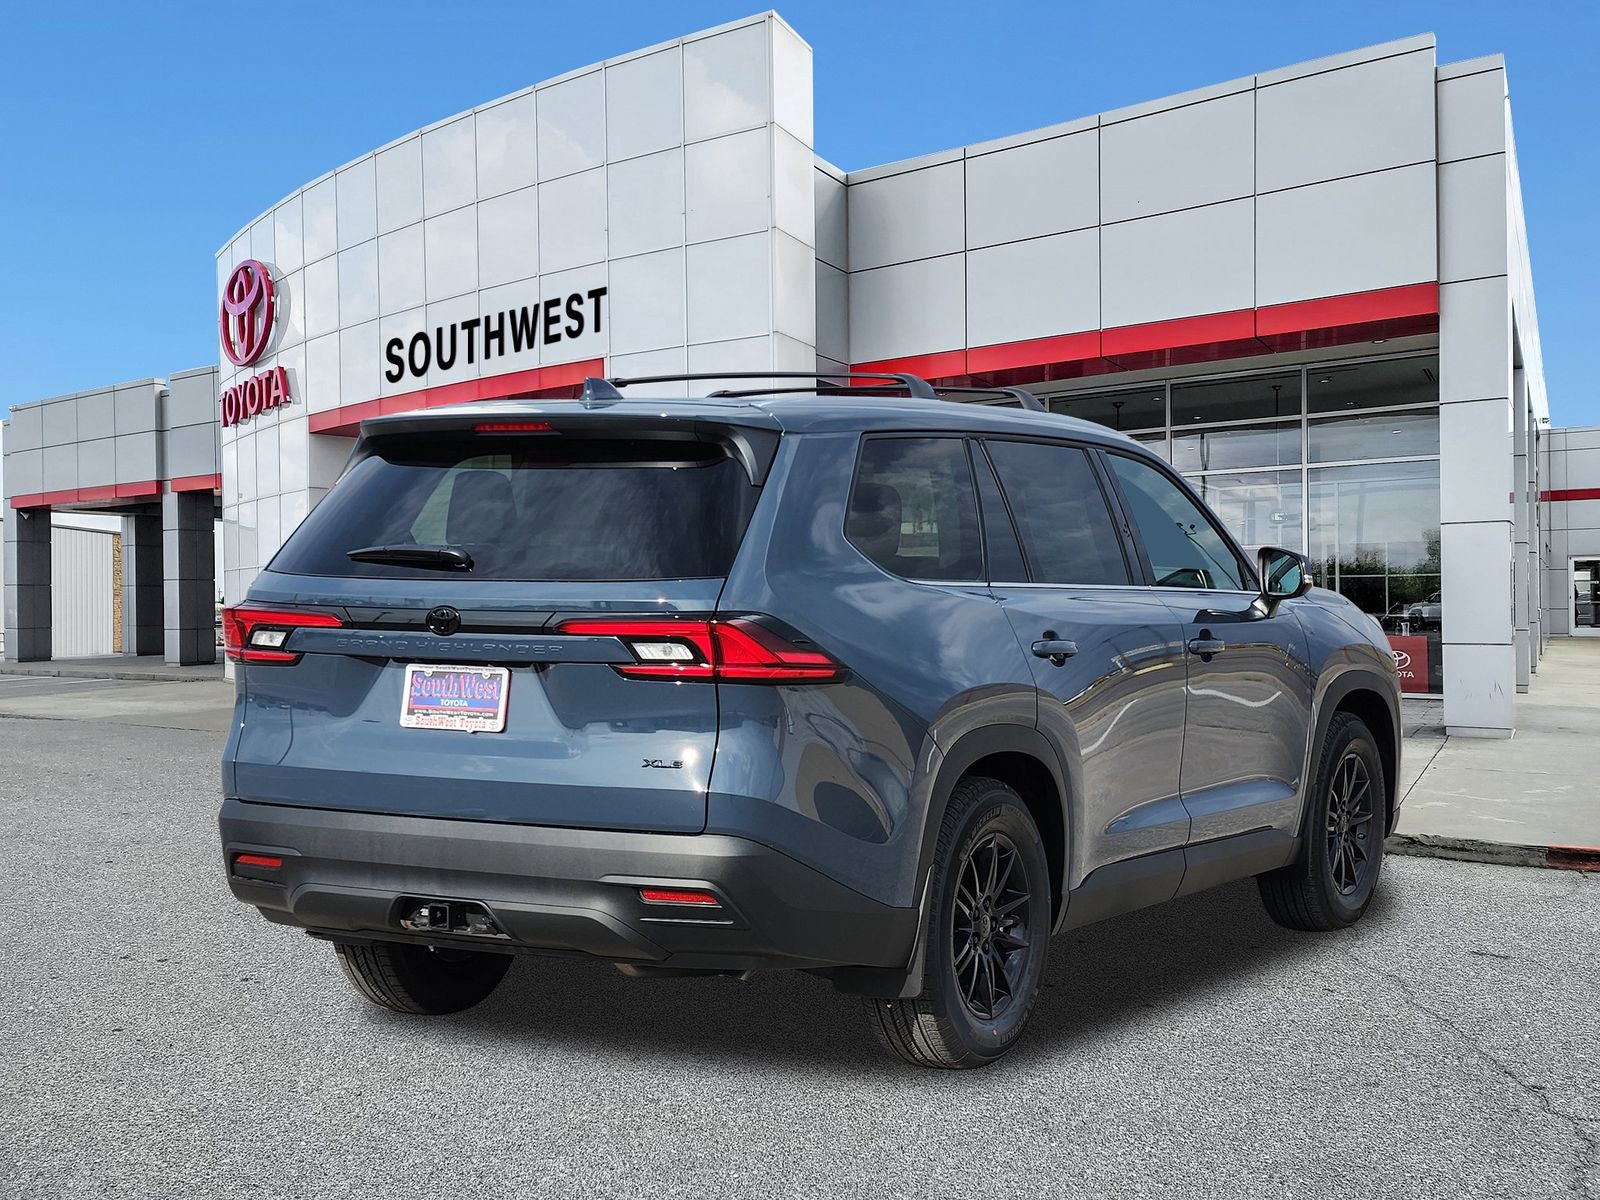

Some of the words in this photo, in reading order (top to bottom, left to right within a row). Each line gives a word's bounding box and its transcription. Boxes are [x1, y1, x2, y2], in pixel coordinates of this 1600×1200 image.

[385, 286, 608, 384] SOUTHWEST
[218, 365, 289, 428] TOYOTA
[440, 699, 468, 707] TOYOTA
[460, 717, 487, 730] Toyota
[641, 758, 684, 769] XLE
